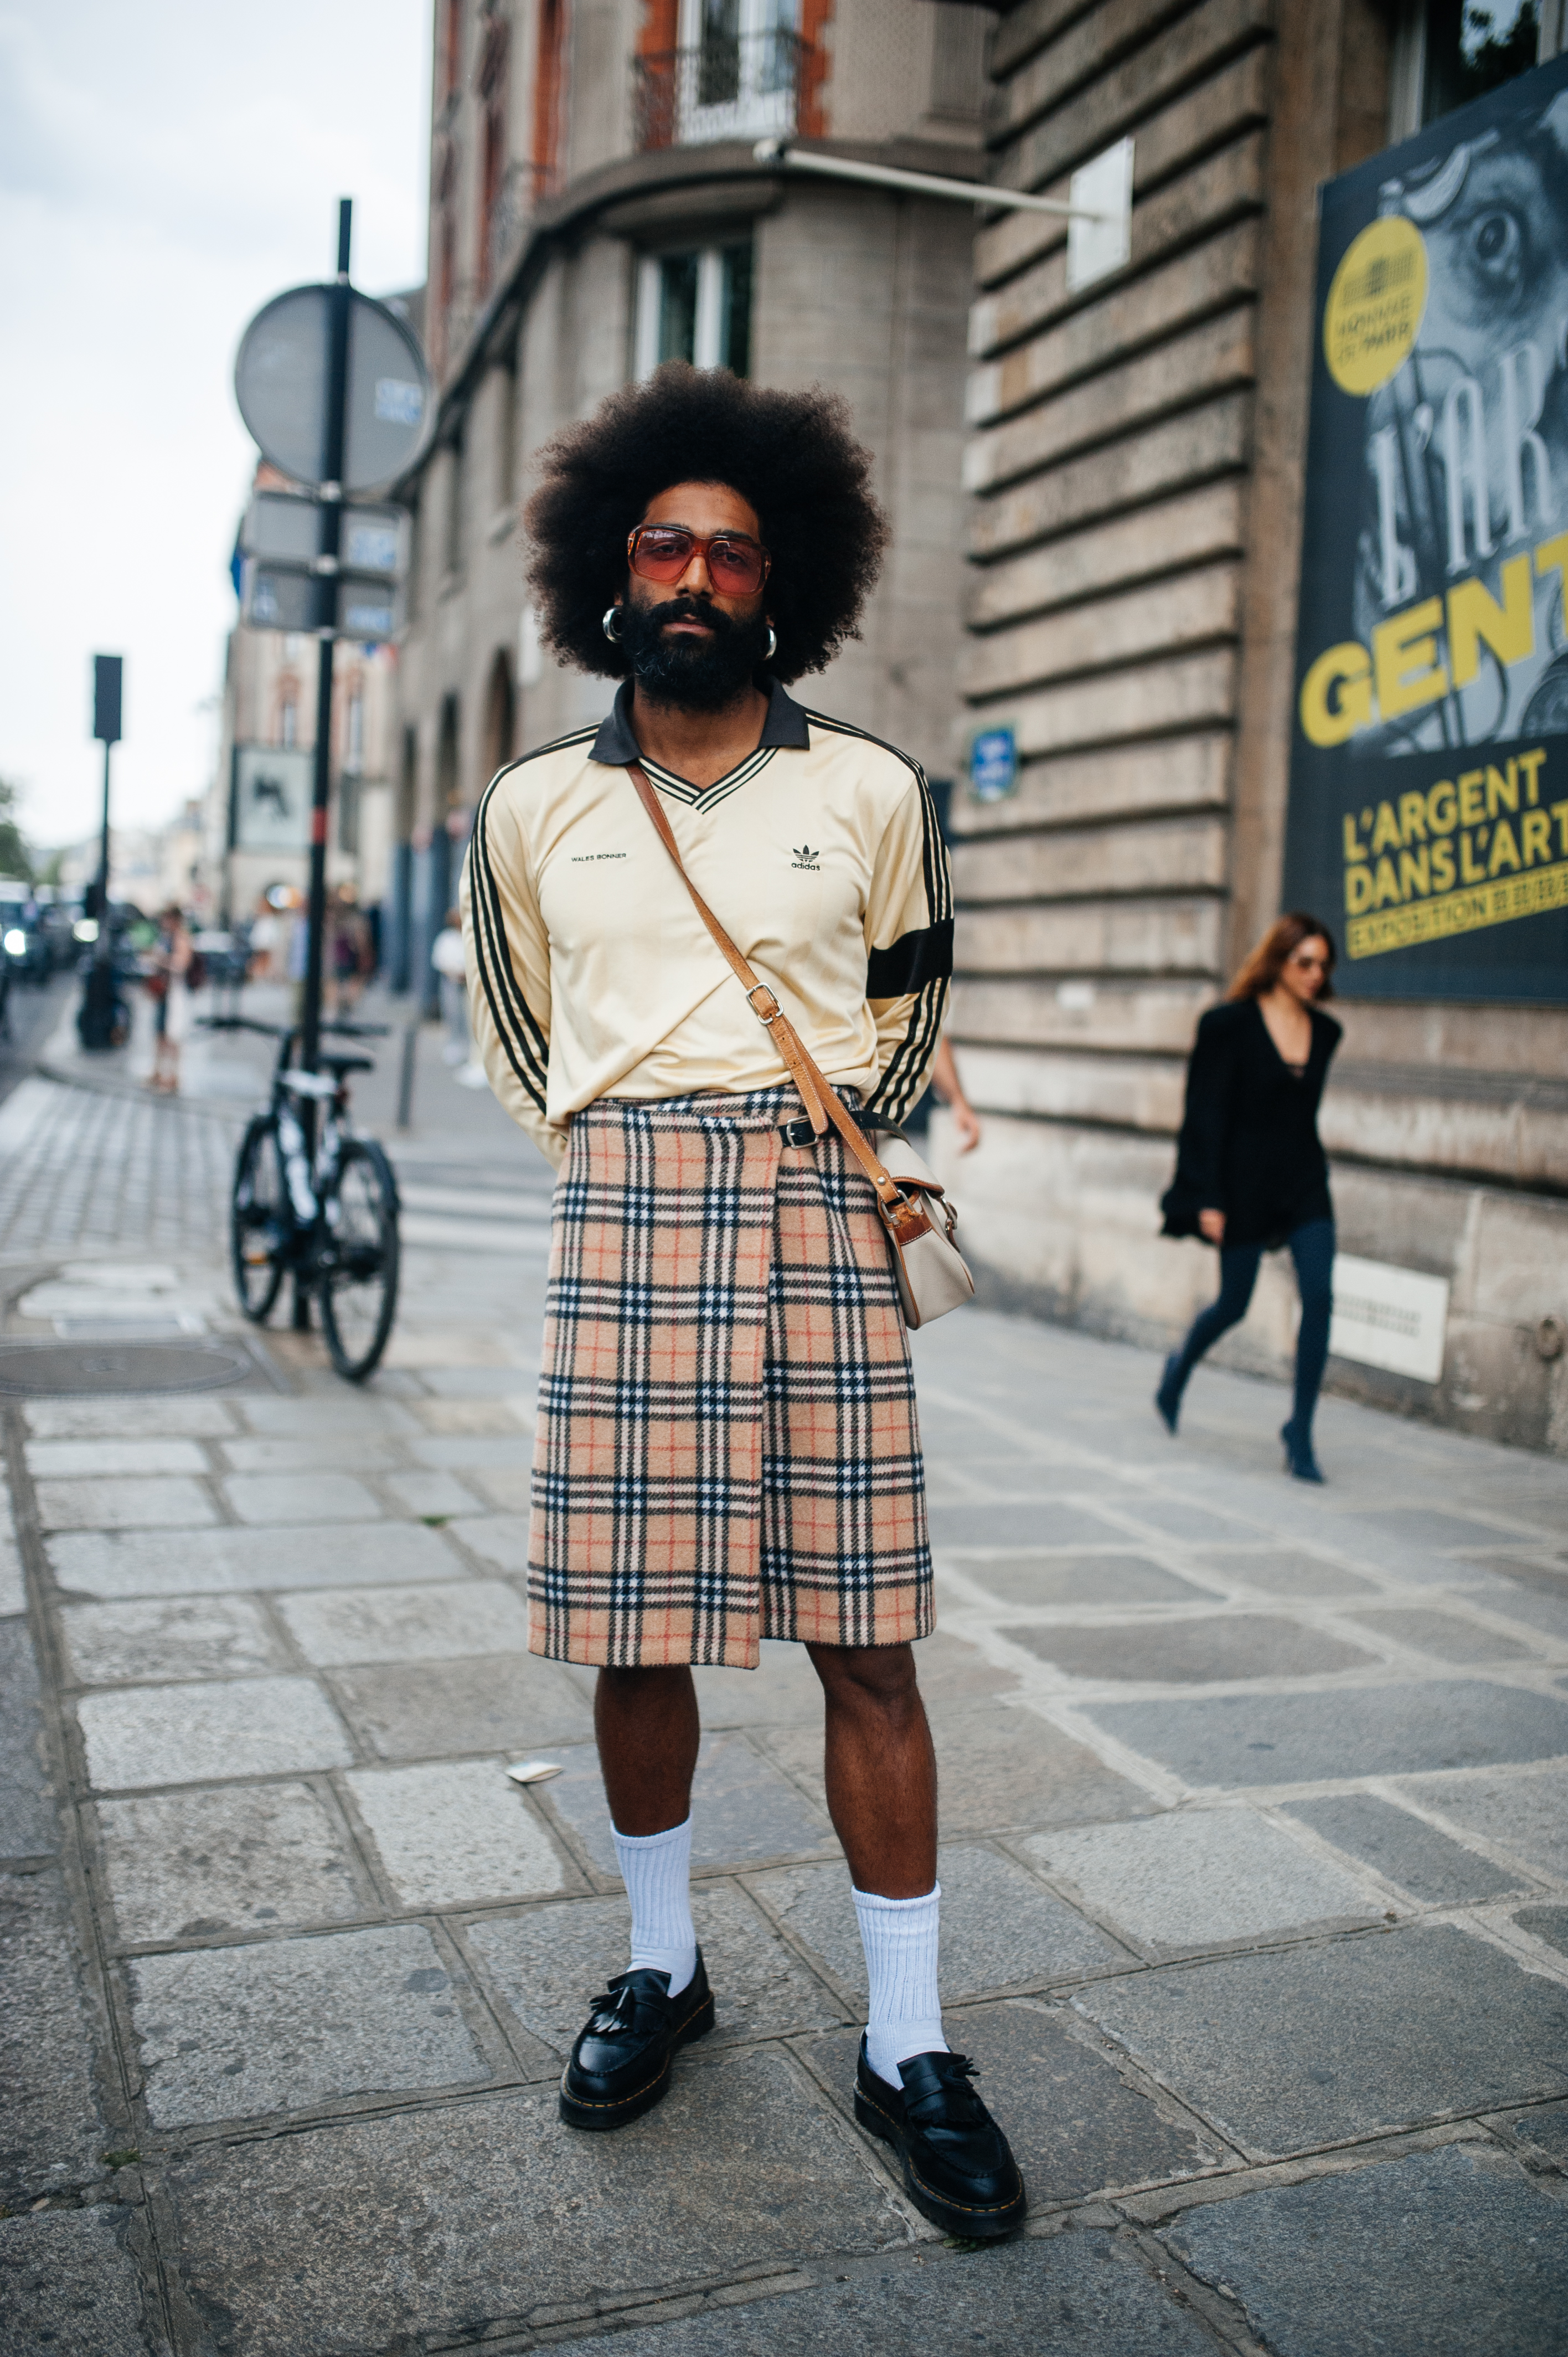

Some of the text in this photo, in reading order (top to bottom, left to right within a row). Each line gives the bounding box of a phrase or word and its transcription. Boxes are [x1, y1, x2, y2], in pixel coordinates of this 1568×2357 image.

[1344, 747, 1546, 861] L'ARGENT
[791, 862, 820, 871] adidas
[1345, 837, 1456, 915] DANS
